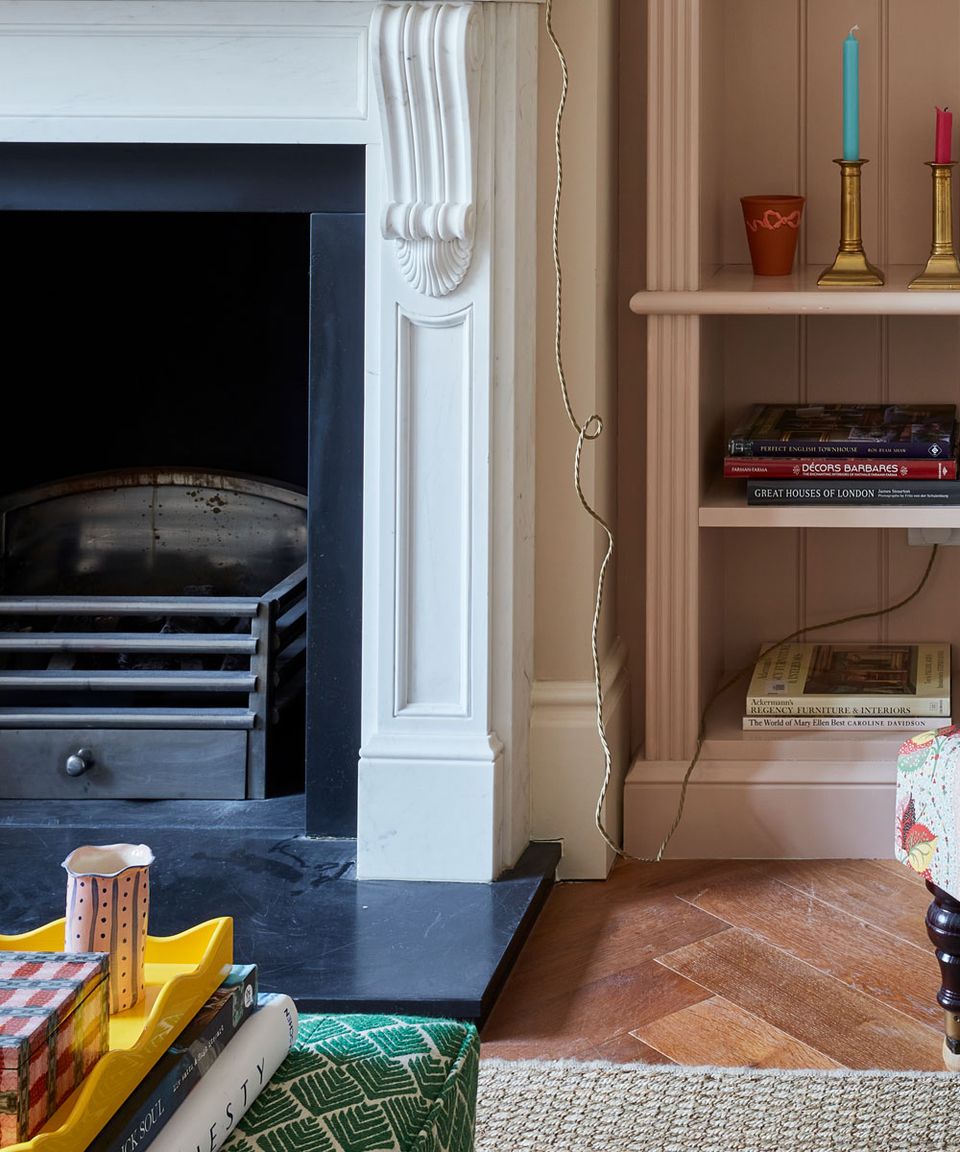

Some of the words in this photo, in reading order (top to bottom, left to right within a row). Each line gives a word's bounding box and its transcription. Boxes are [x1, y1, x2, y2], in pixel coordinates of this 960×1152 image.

[802, 461, 841, 472] DÉCORS
[844, 464, 898, 472] BARBARES
[754, 488, 784, 498] GREAT
[786, 488, 820, 498] HOUSES
[823, 488, 836, 498] OF
[837, 488, 875, 498] LONDON
[793, 719, 810, 727] Mary
[139, 1099, 165, 1135] SOUL
